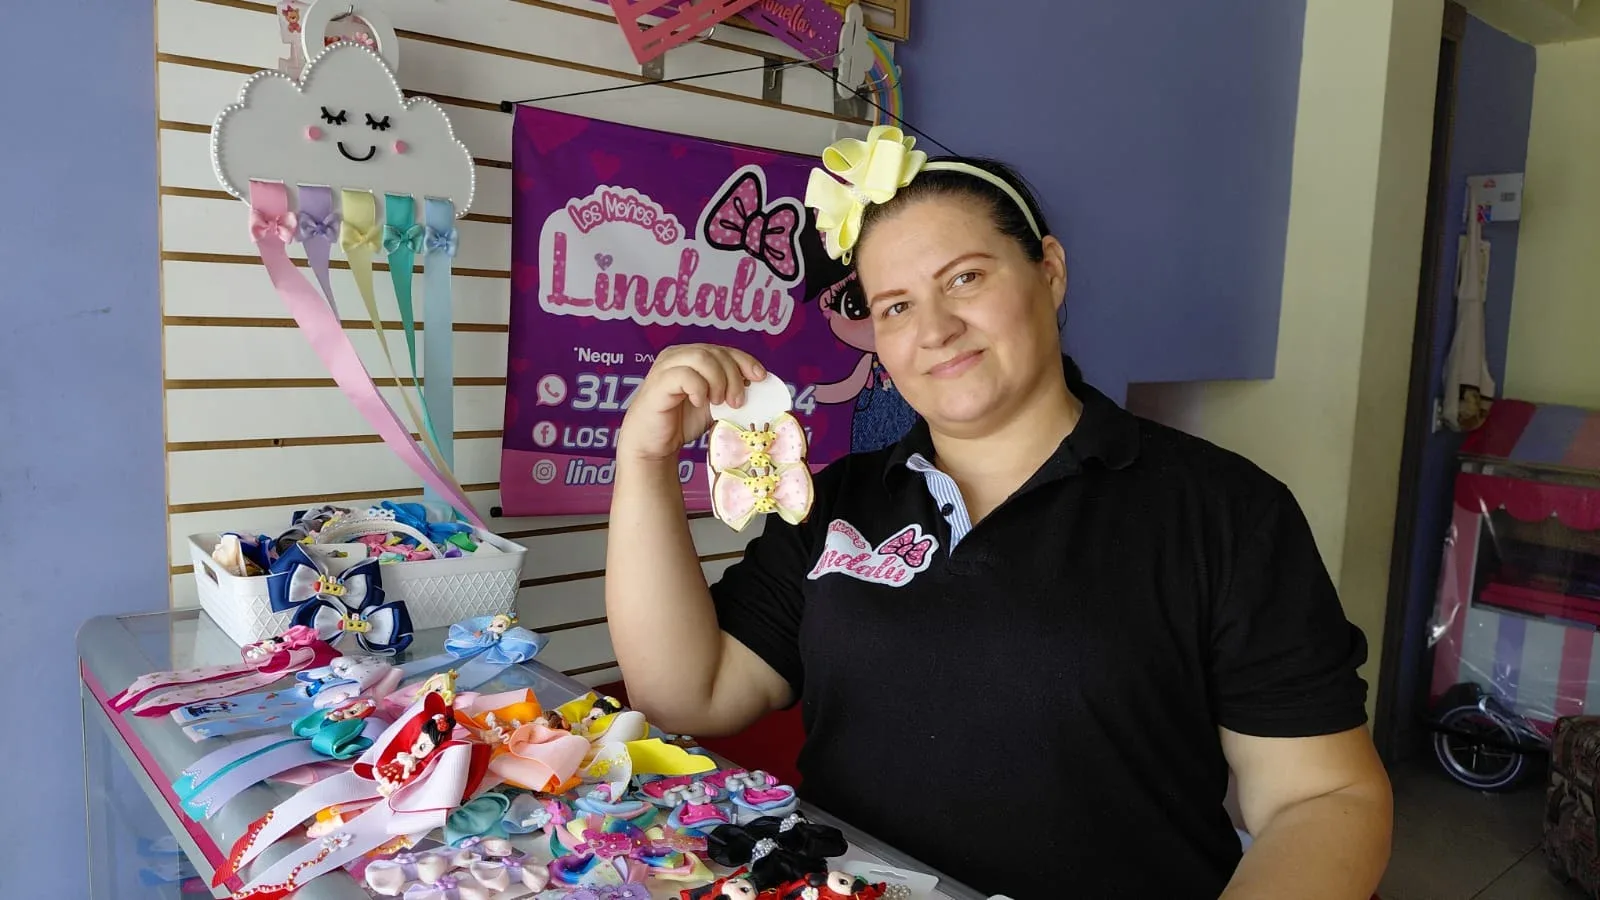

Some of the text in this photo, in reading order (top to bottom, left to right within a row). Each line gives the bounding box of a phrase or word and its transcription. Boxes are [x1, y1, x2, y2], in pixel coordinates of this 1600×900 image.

[602, 191, 657, 229] Moños
[547, 231, 789, 327] Lindalú
[563, 427, 609, 448] LOS
